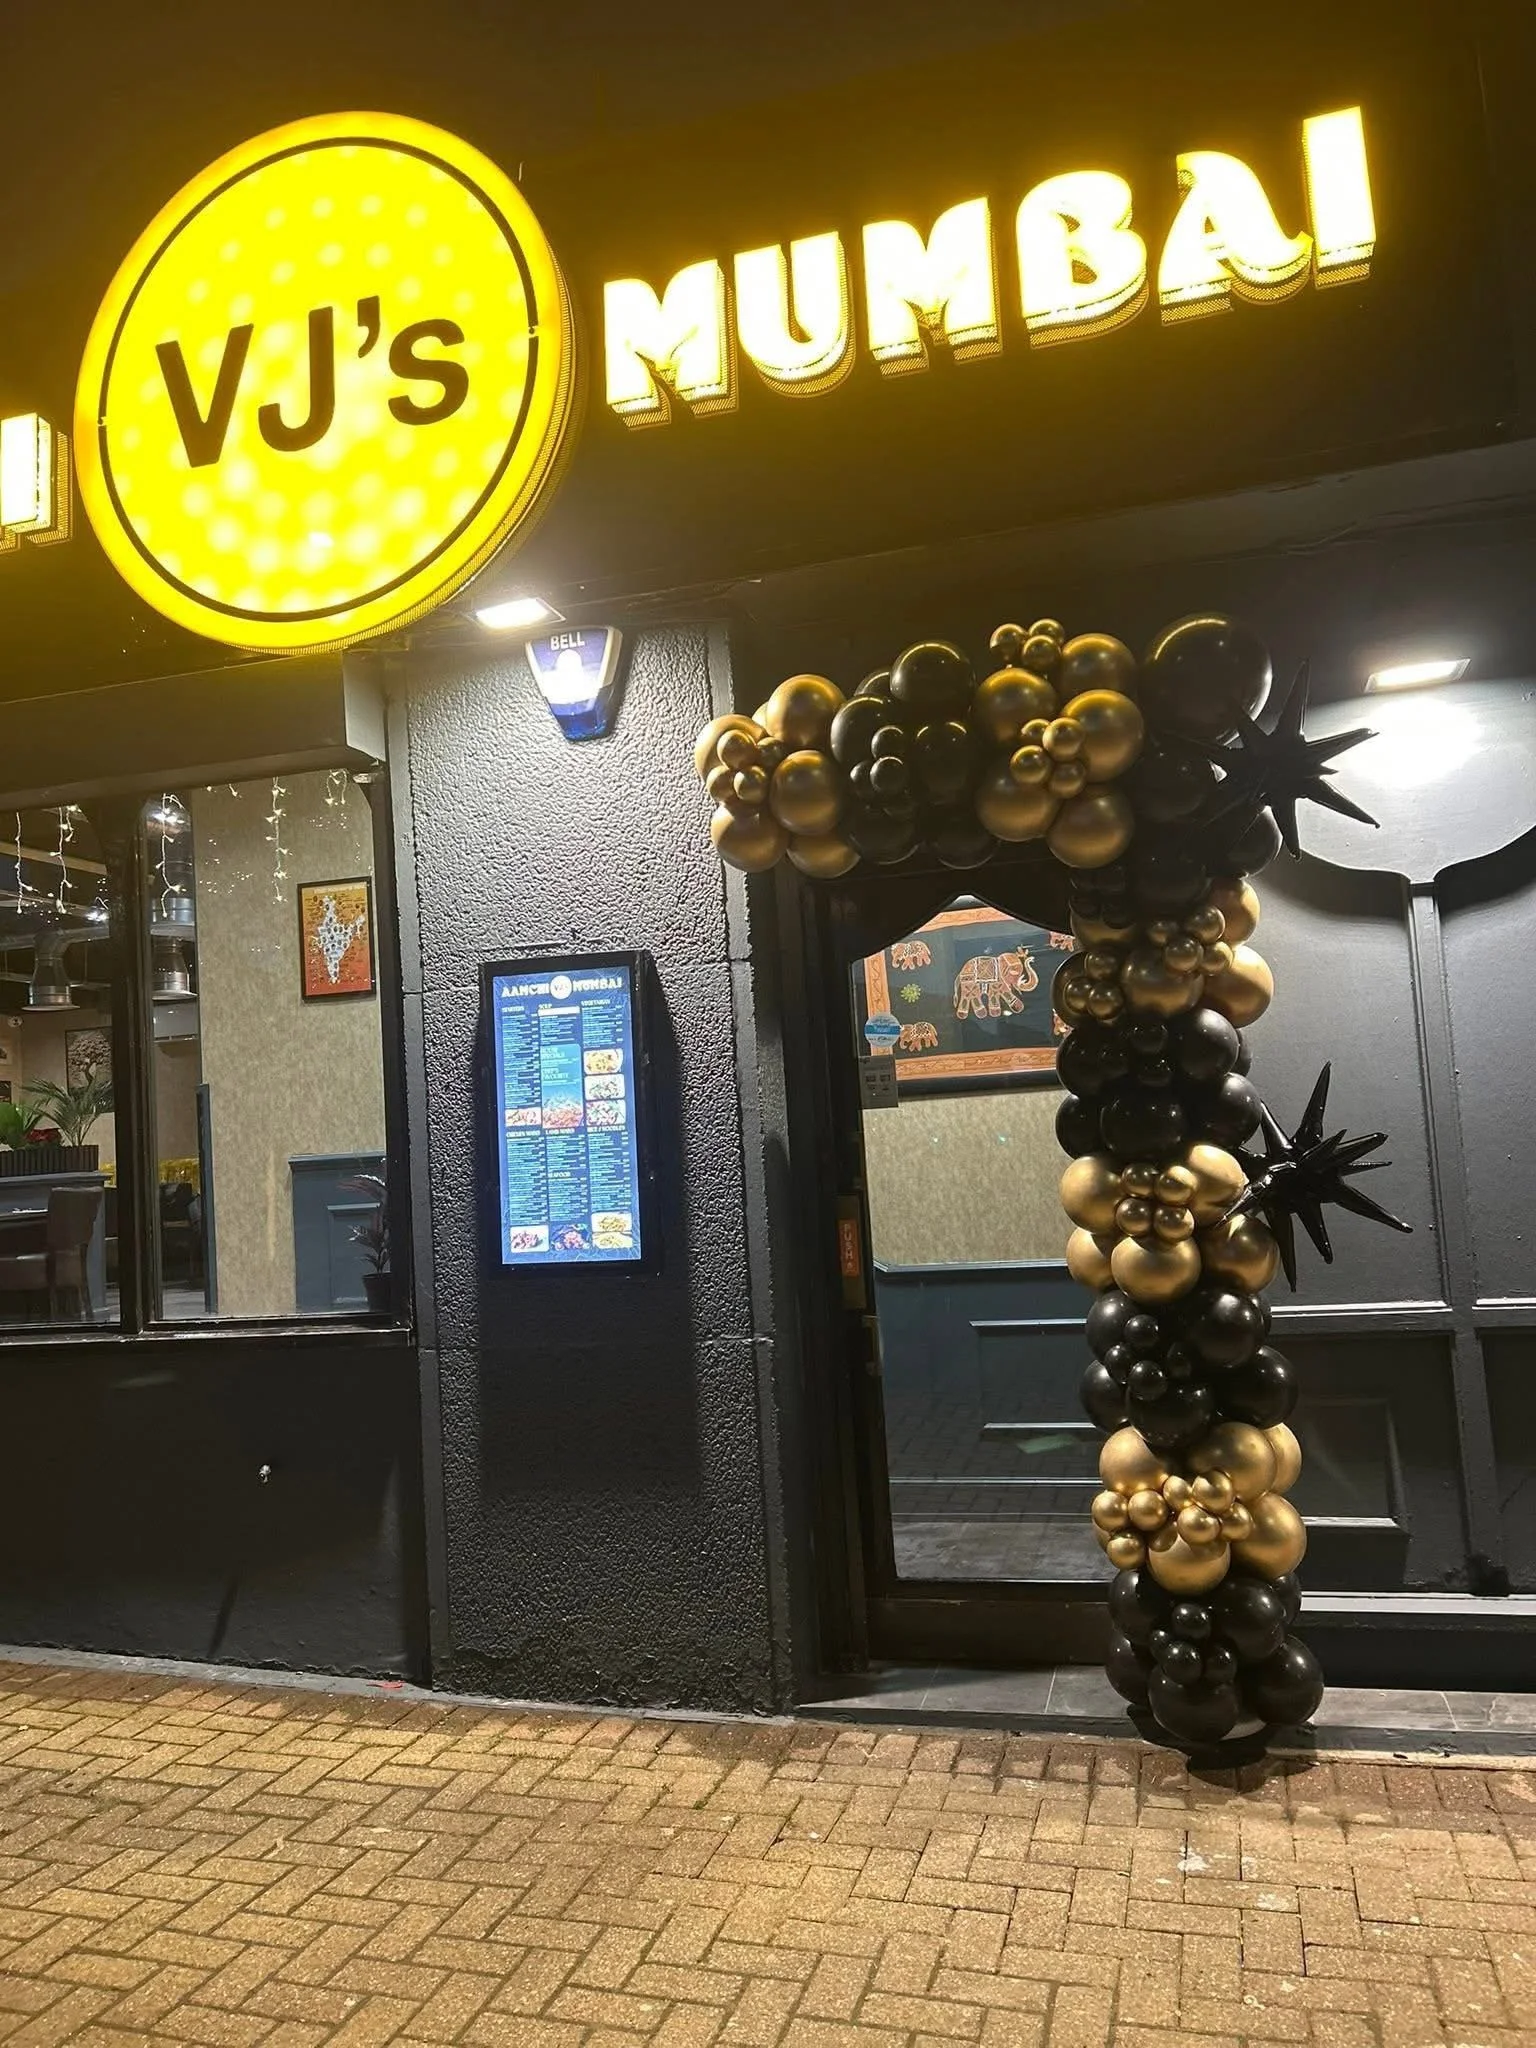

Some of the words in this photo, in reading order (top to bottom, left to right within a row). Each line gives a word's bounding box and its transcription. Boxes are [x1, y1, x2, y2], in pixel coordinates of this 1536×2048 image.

[604, 106, 1377, 424] MUMBAI
[155, 295, 469, 468] VJ's
[550, 631, 585, 651] BELL
[844, 1223, 853, 1260] PUSH
